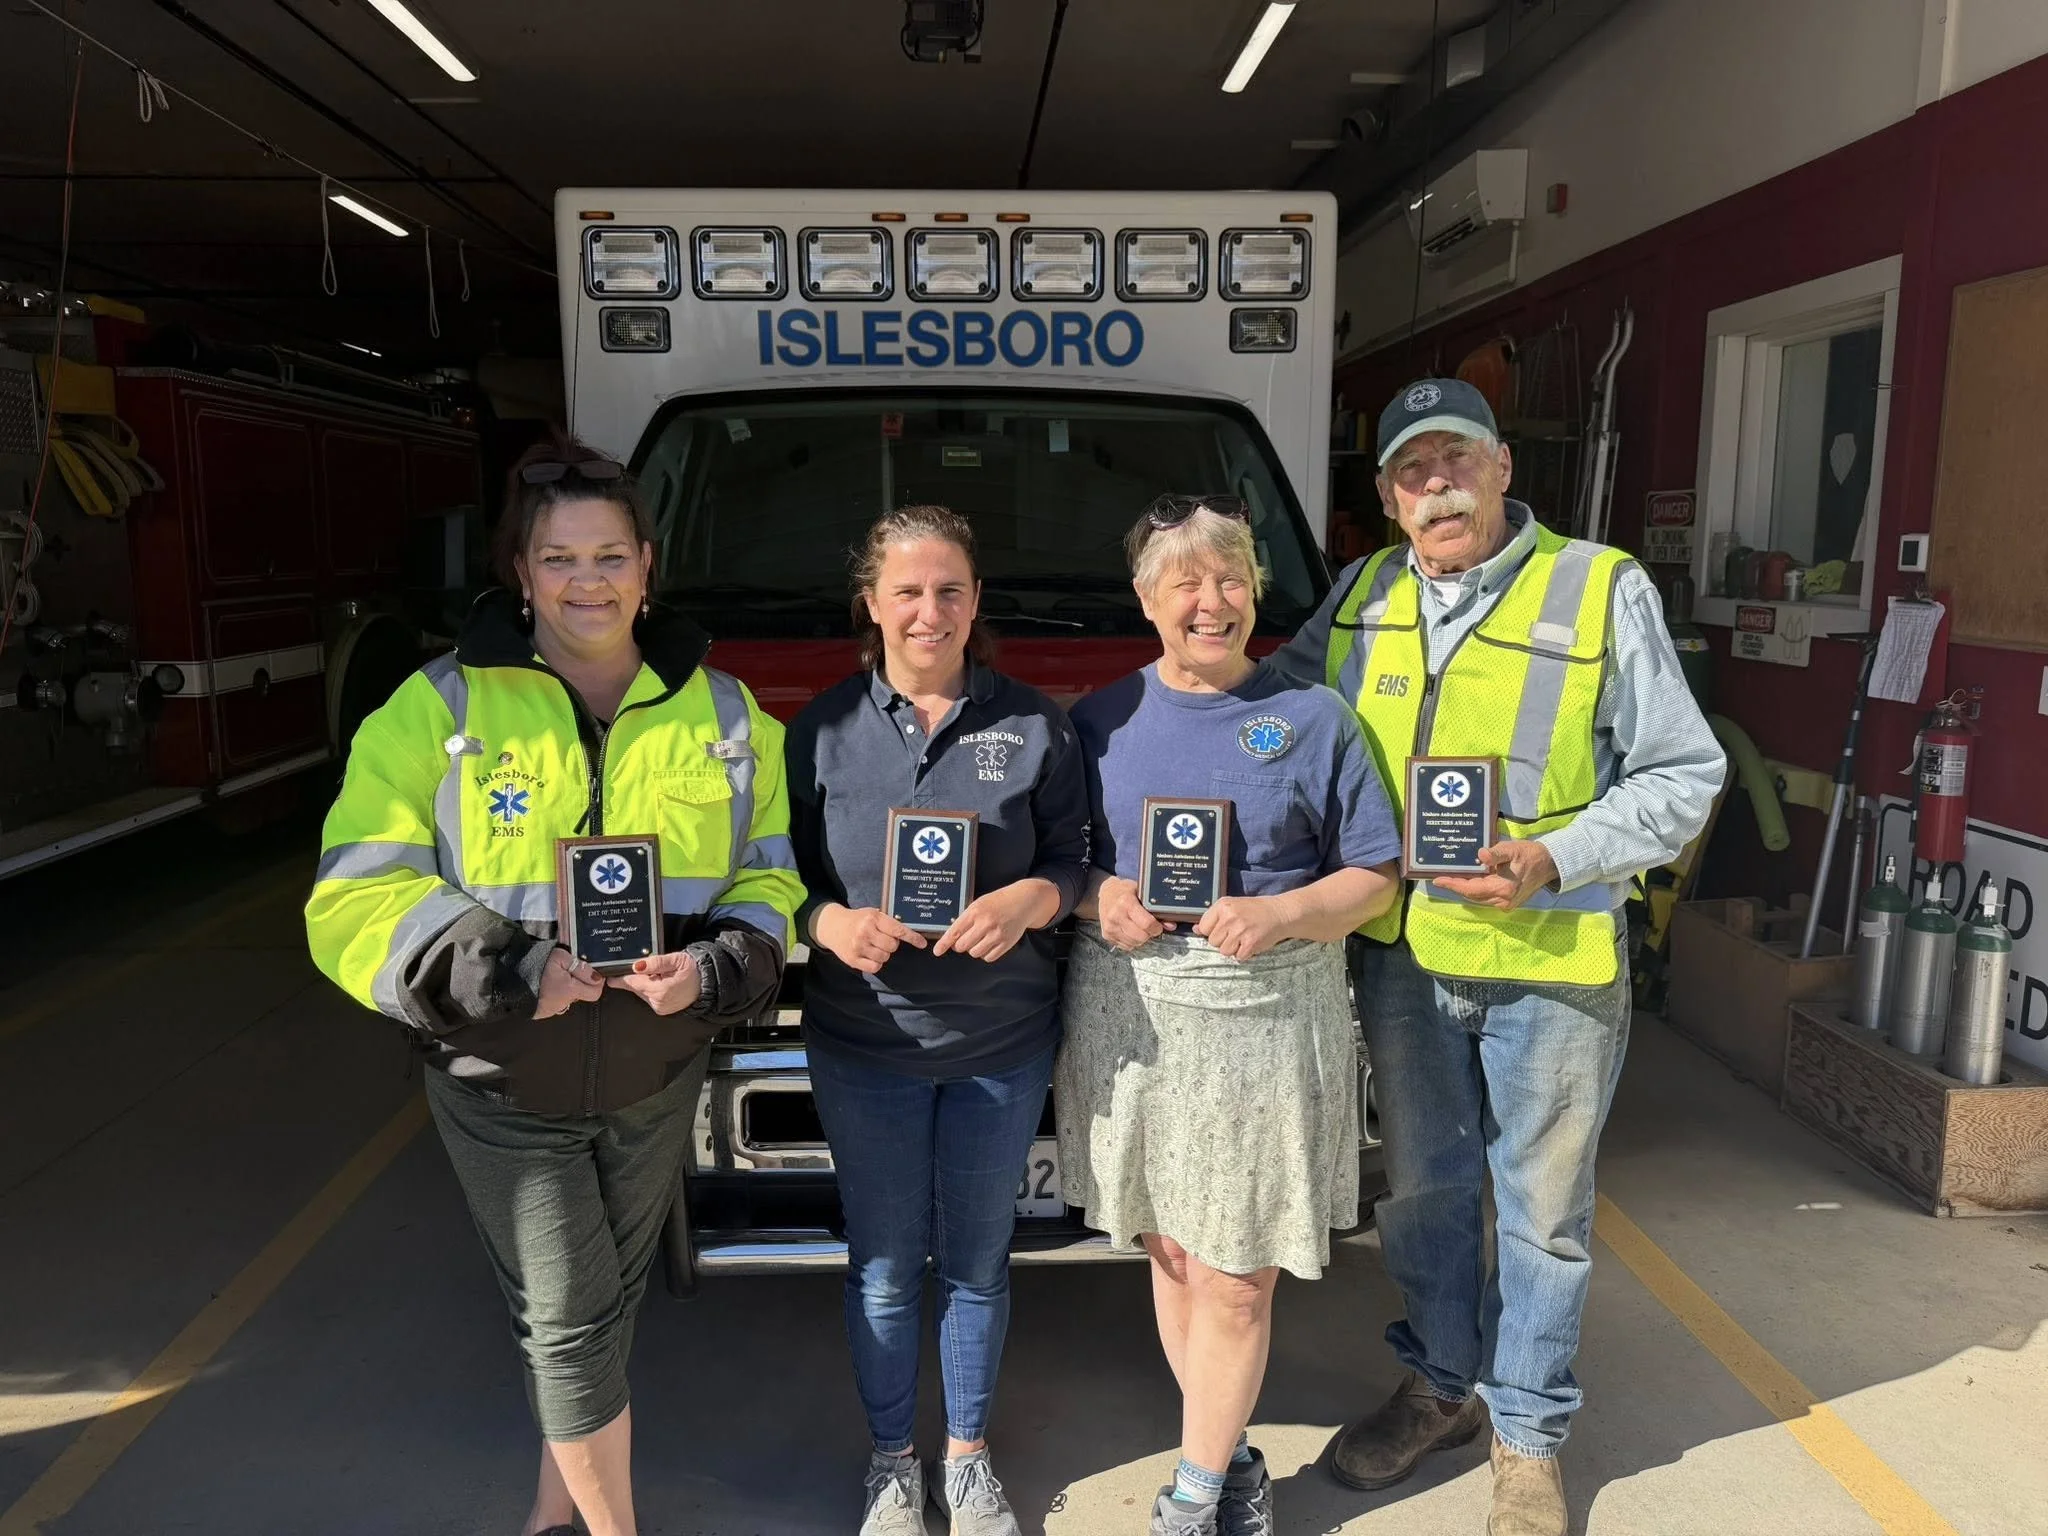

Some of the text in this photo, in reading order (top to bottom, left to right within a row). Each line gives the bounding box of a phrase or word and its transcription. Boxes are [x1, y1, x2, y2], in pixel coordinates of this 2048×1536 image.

[757, 309, 1144, 368] ISLESBORO
[1653, 502, 1689, 518] DANGER
[1375, 674, 1409, 697] EMS
[1244, 716, 1291, 730] ISLESBORO
[959, 732, 1024, 745] ISLESBORO
[475, 769, 545, 788] Islesboro
[978, 769, 1004, 781] EMS
[491, 826, 525, 837] EMS
[1909, 855, 2033, 940] ROAD
